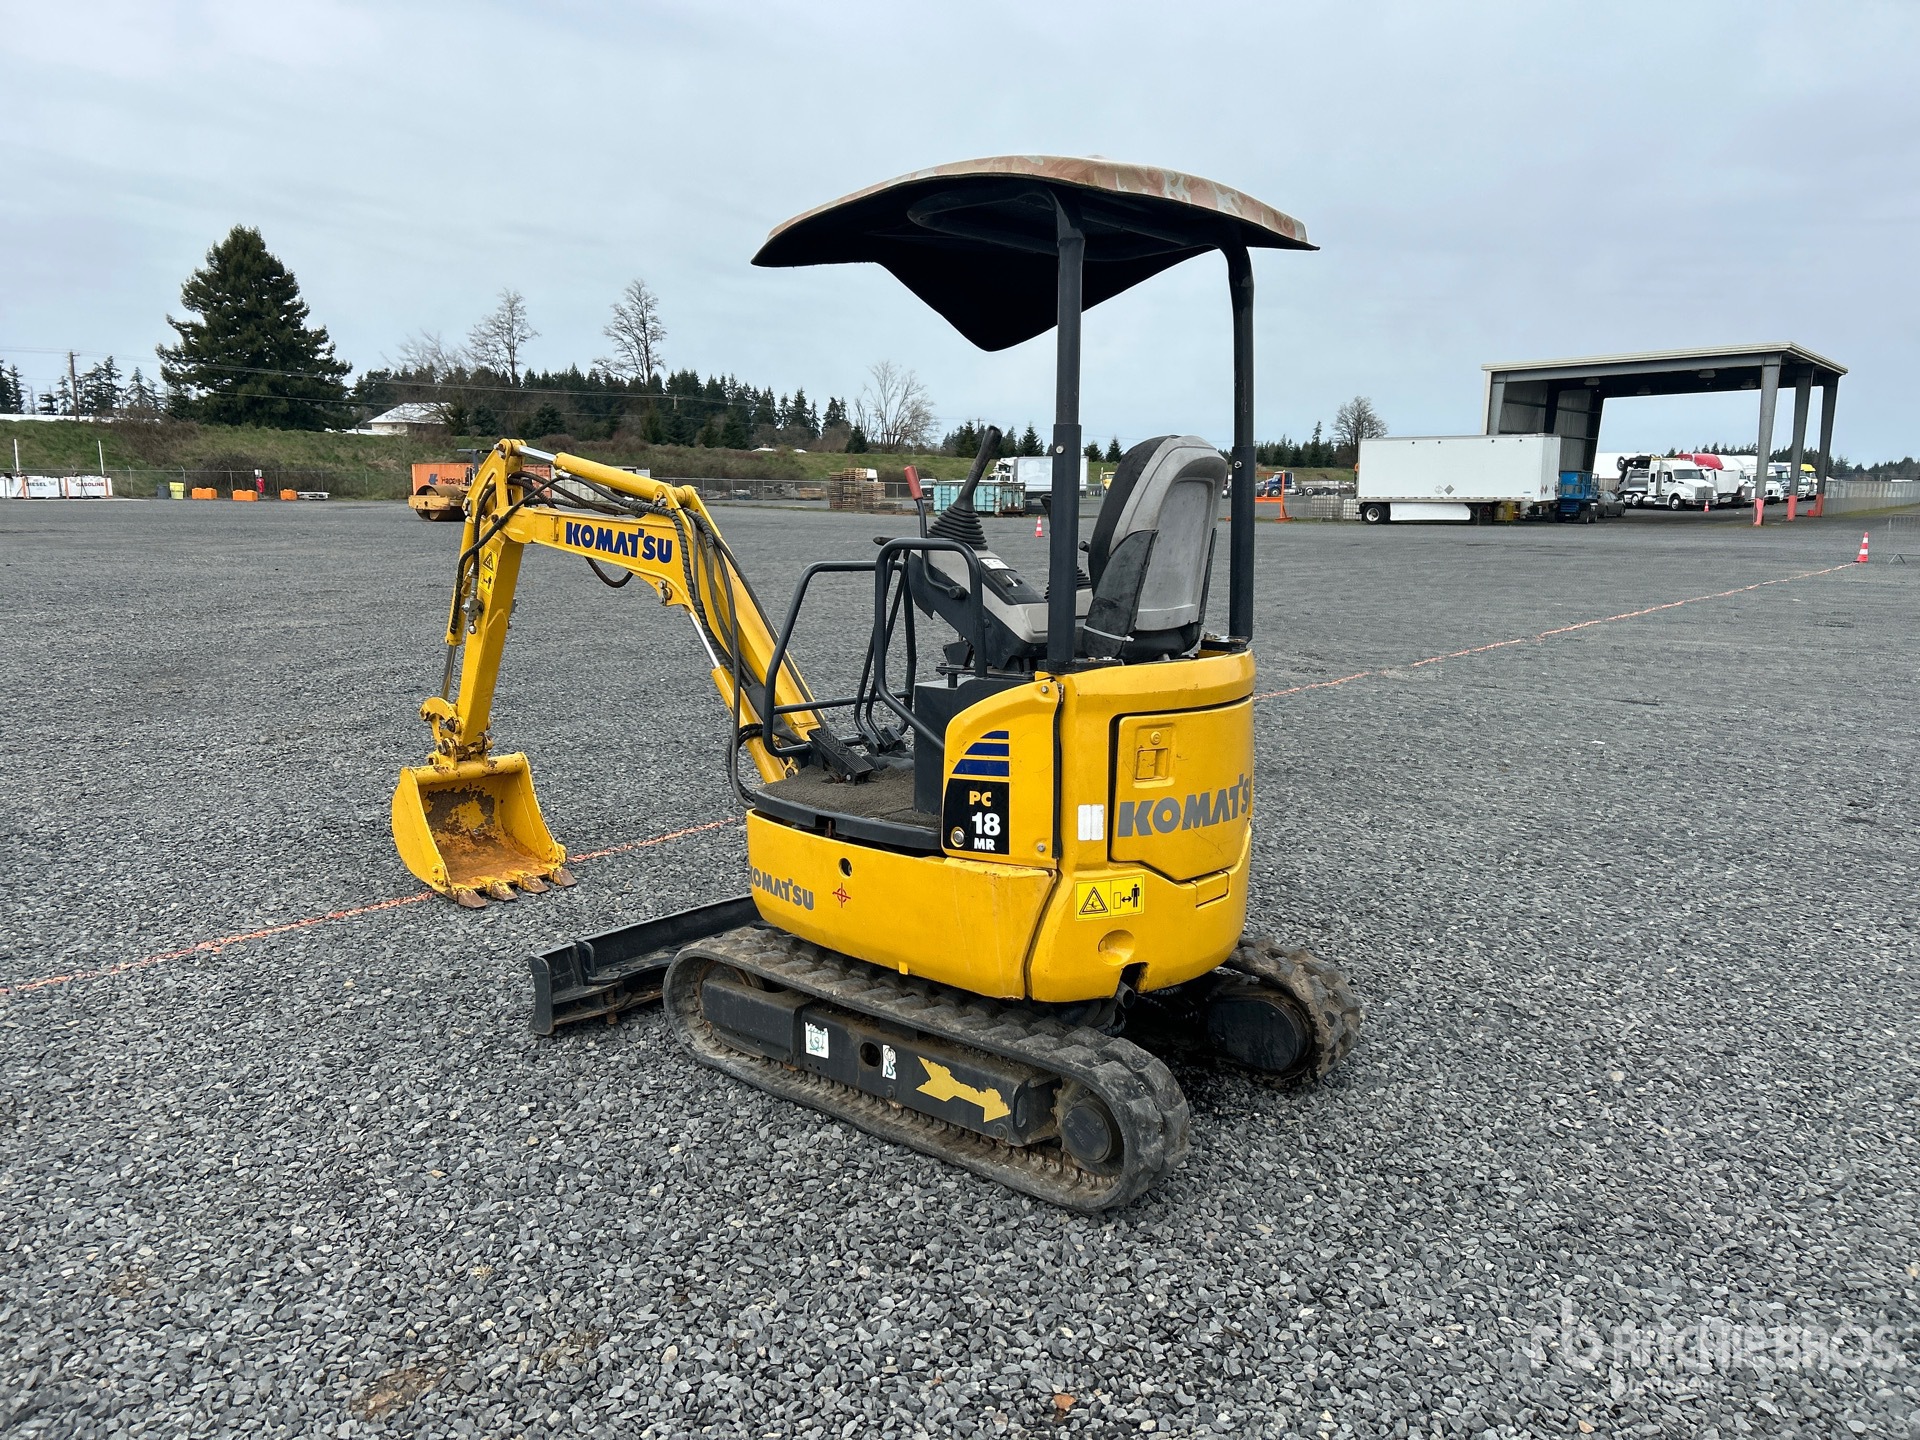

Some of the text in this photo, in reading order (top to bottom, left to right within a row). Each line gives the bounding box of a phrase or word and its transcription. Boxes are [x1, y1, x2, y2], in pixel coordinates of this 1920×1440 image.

[565, 521, 673, 564] KOMATSU
[969, 790, 992, 807] PC
[1117, 773, 1250, 838] KOMATS
[971, 811, 1001, 836] 18
[973, 837, 996, 851] MR
